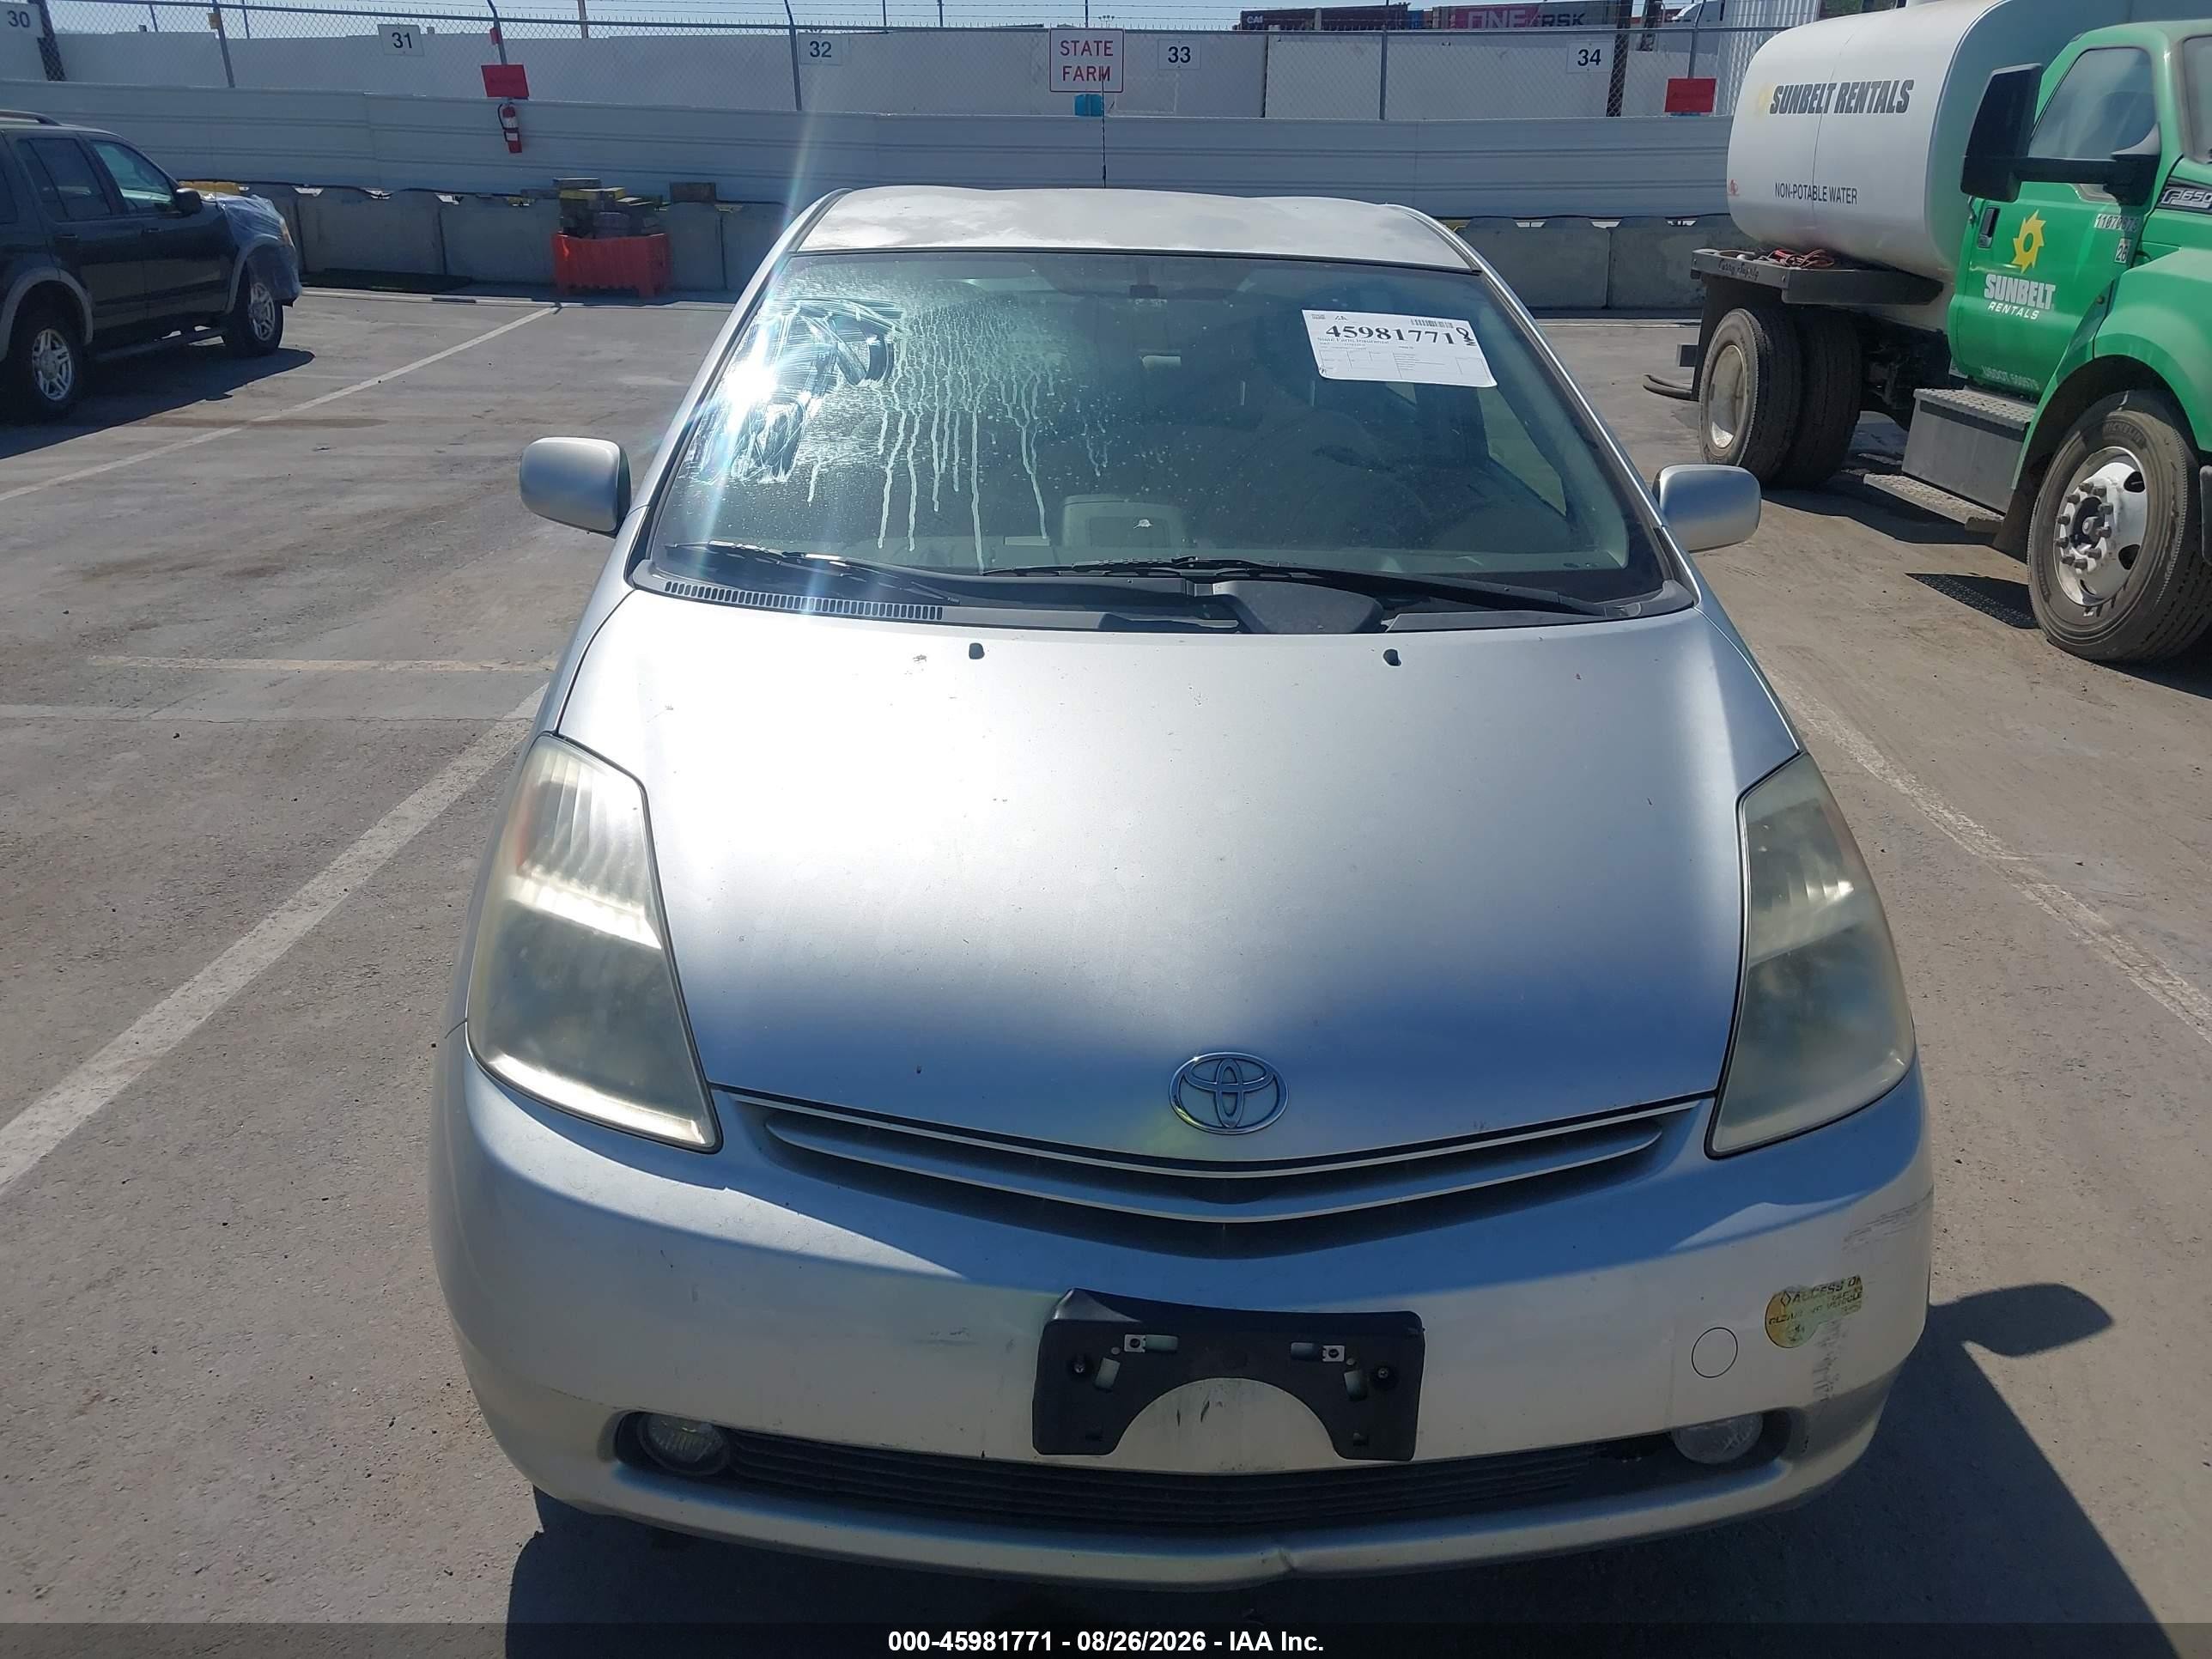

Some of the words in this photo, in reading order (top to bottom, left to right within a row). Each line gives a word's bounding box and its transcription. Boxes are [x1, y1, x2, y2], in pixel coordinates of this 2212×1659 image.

[8, 10, 30, 27] 30
[392, 33, 412, 49] 31
[810, 40, 831, 58] 32
[1060, 40, 1114, 57] STATE
[1168, 46, 1191, 64] 33
[1577, 49, 1601, 67] 34
[1062, 65, 1110, 82] FARM
[1770, 83, 1838, 114] SUNBELT
[1833, 79, 1914, 114] RENTALS
[1775, 182, 1827, 202] NON-POTABLE
[1829, 187, 1857, 204] WATER
[2116, 245, 2129, 263] 26
[1984, 274, 2056, 310] SUNBELT
[1988, 301, 2039, 320] RENTALS
[1325, 325, 1457, 345] 45981771
